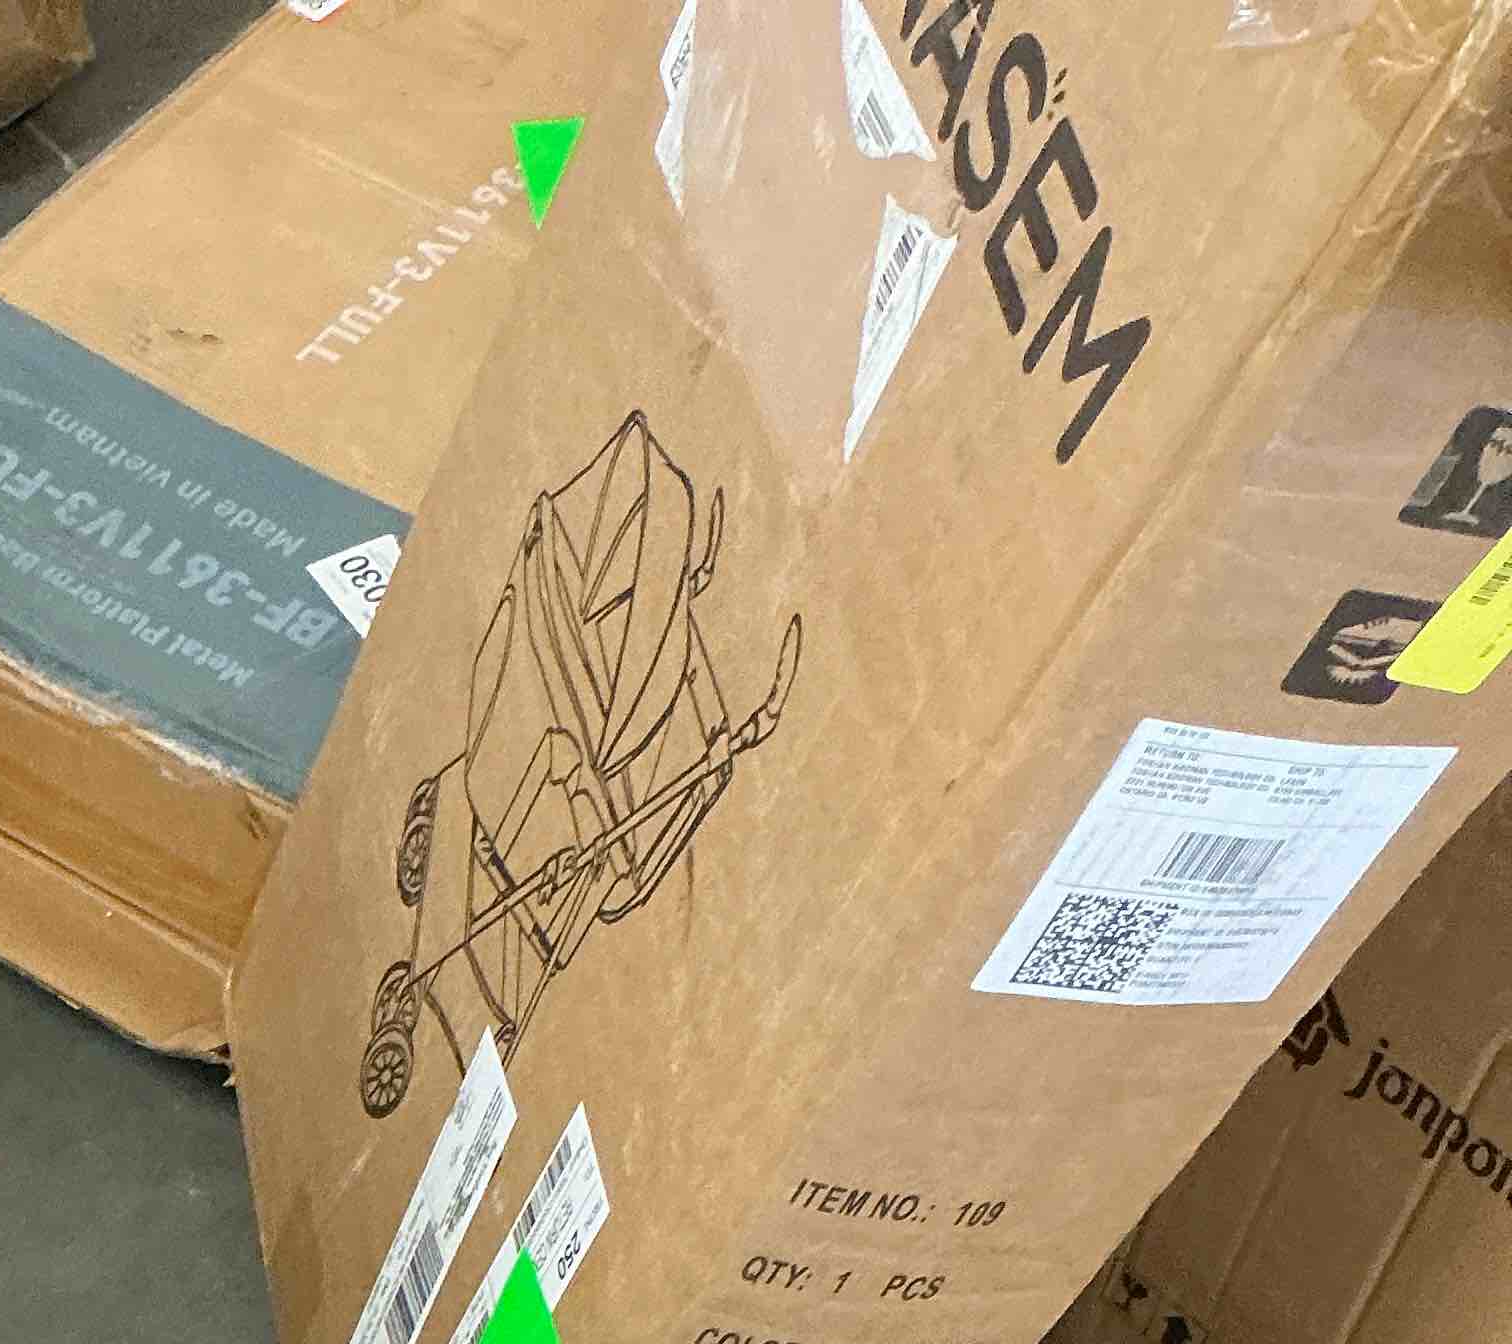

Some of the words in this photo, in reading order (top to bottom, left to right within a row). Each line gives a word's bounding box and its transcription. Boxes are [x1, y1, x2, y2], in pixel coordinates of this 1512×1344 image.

[177, 478, 212, 508] in
[214, 500, 306, 557] Made
[165, 635, 256, 688] Metal
[951, 1199, 1007, 1229] 109
[556, 1230, 582, 1281] 250
[740, 1254, 813, 1294] QTY:
[833, 1271, 849, 1295] 1
[881, 1273, 948, 1302] PCS
